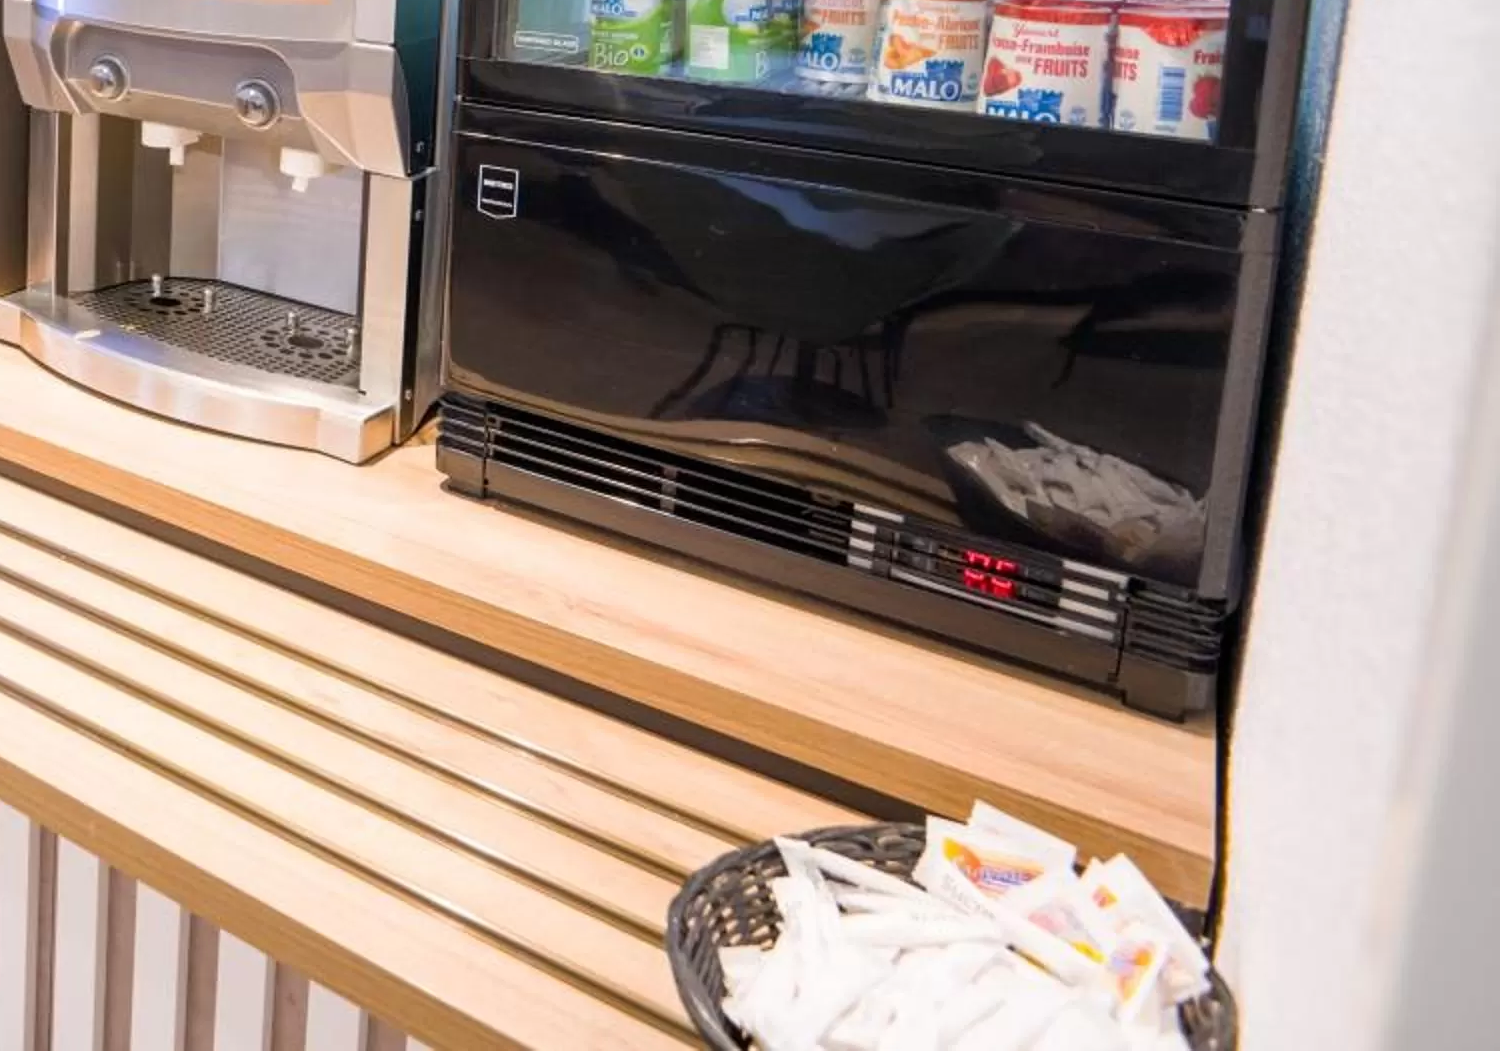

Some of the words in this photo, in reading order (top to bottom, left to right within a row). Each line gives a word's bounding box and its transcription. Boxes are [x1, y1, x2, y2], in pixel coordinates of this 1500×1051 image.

[596, 43, 630, 69] Bio
[1033, 57, 1090, 78] FRUITS
[894, 77, 960, 100] MALO
